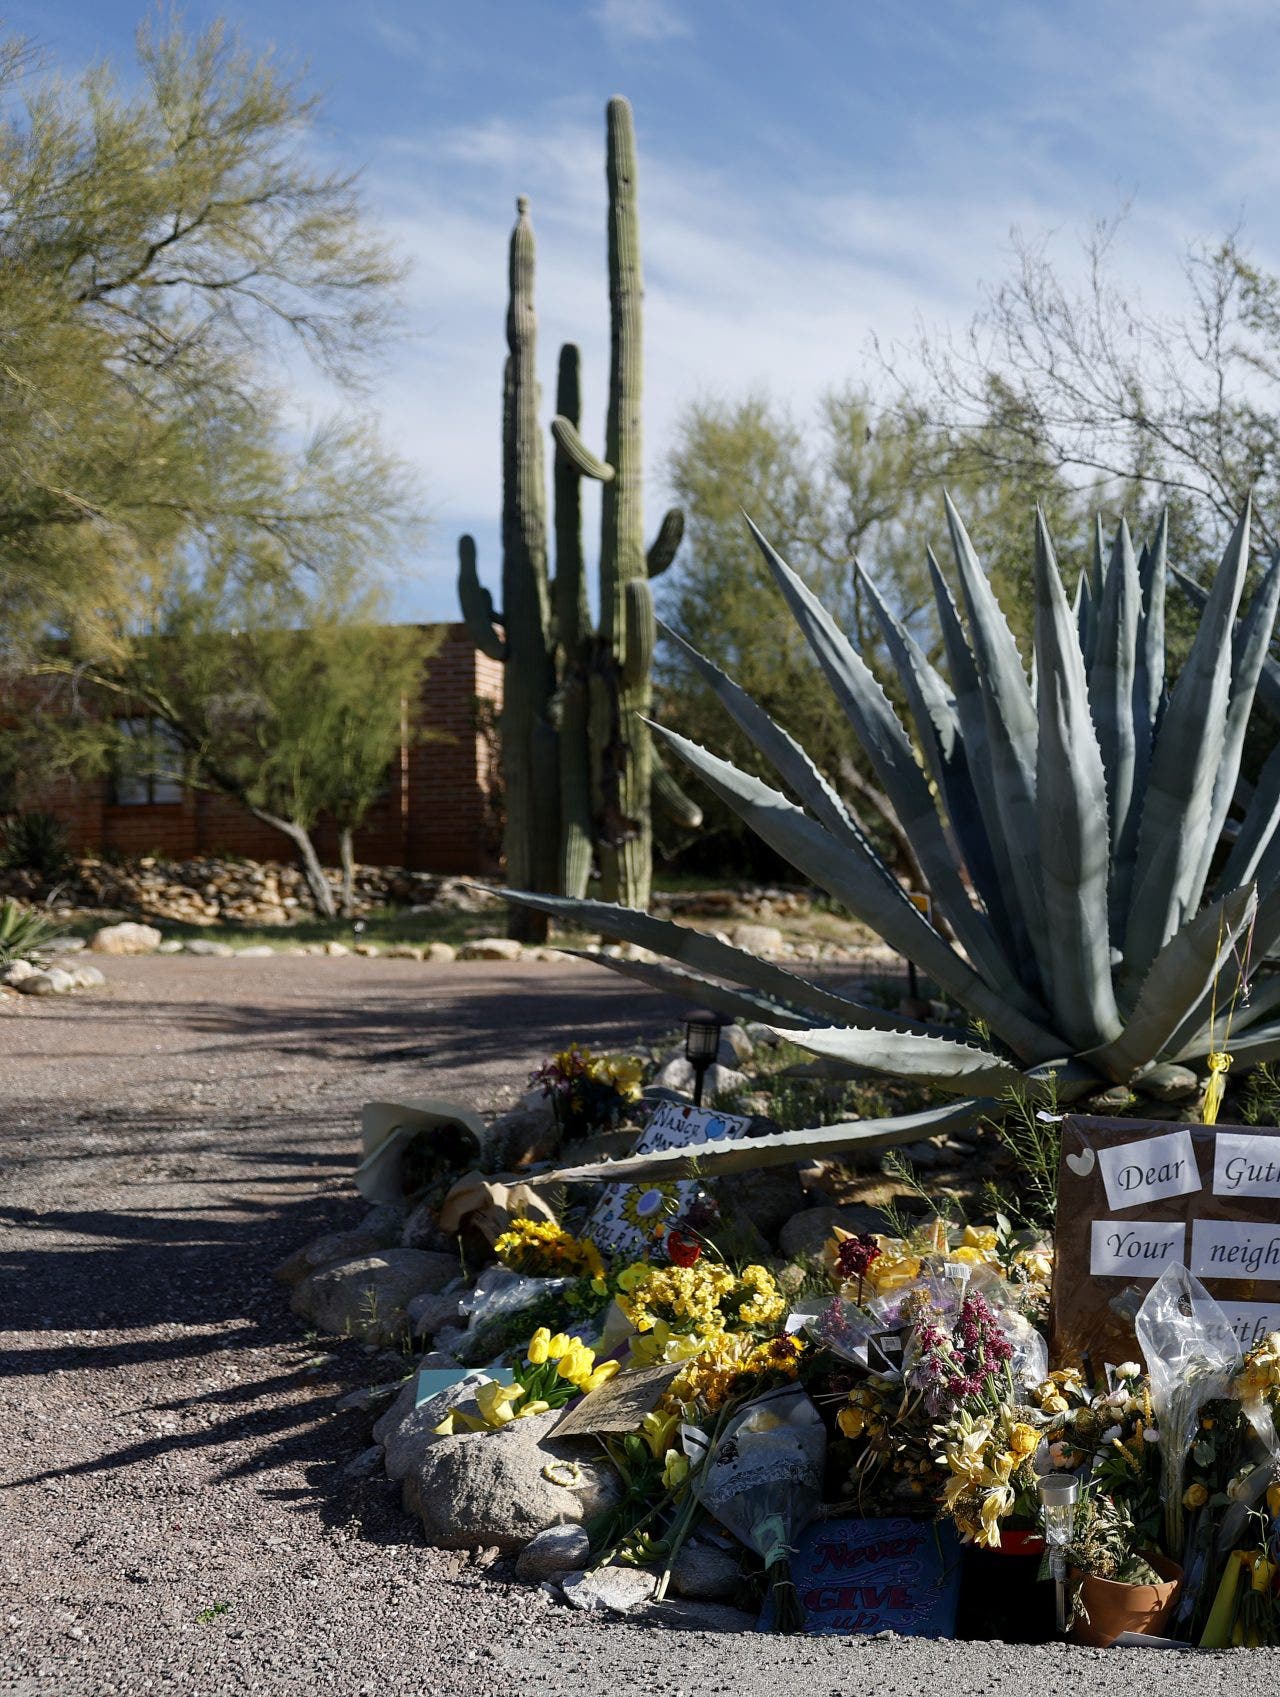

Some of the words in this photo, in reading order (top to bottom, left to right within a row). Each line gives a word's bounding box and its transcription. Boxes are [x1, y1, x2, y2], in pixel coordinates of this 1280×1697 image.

[1118, 1159, 1186, 1191] Dear
[1107, 1233, 1175, 1260] Your
[804, 1584, 917, 1612] GIVE
